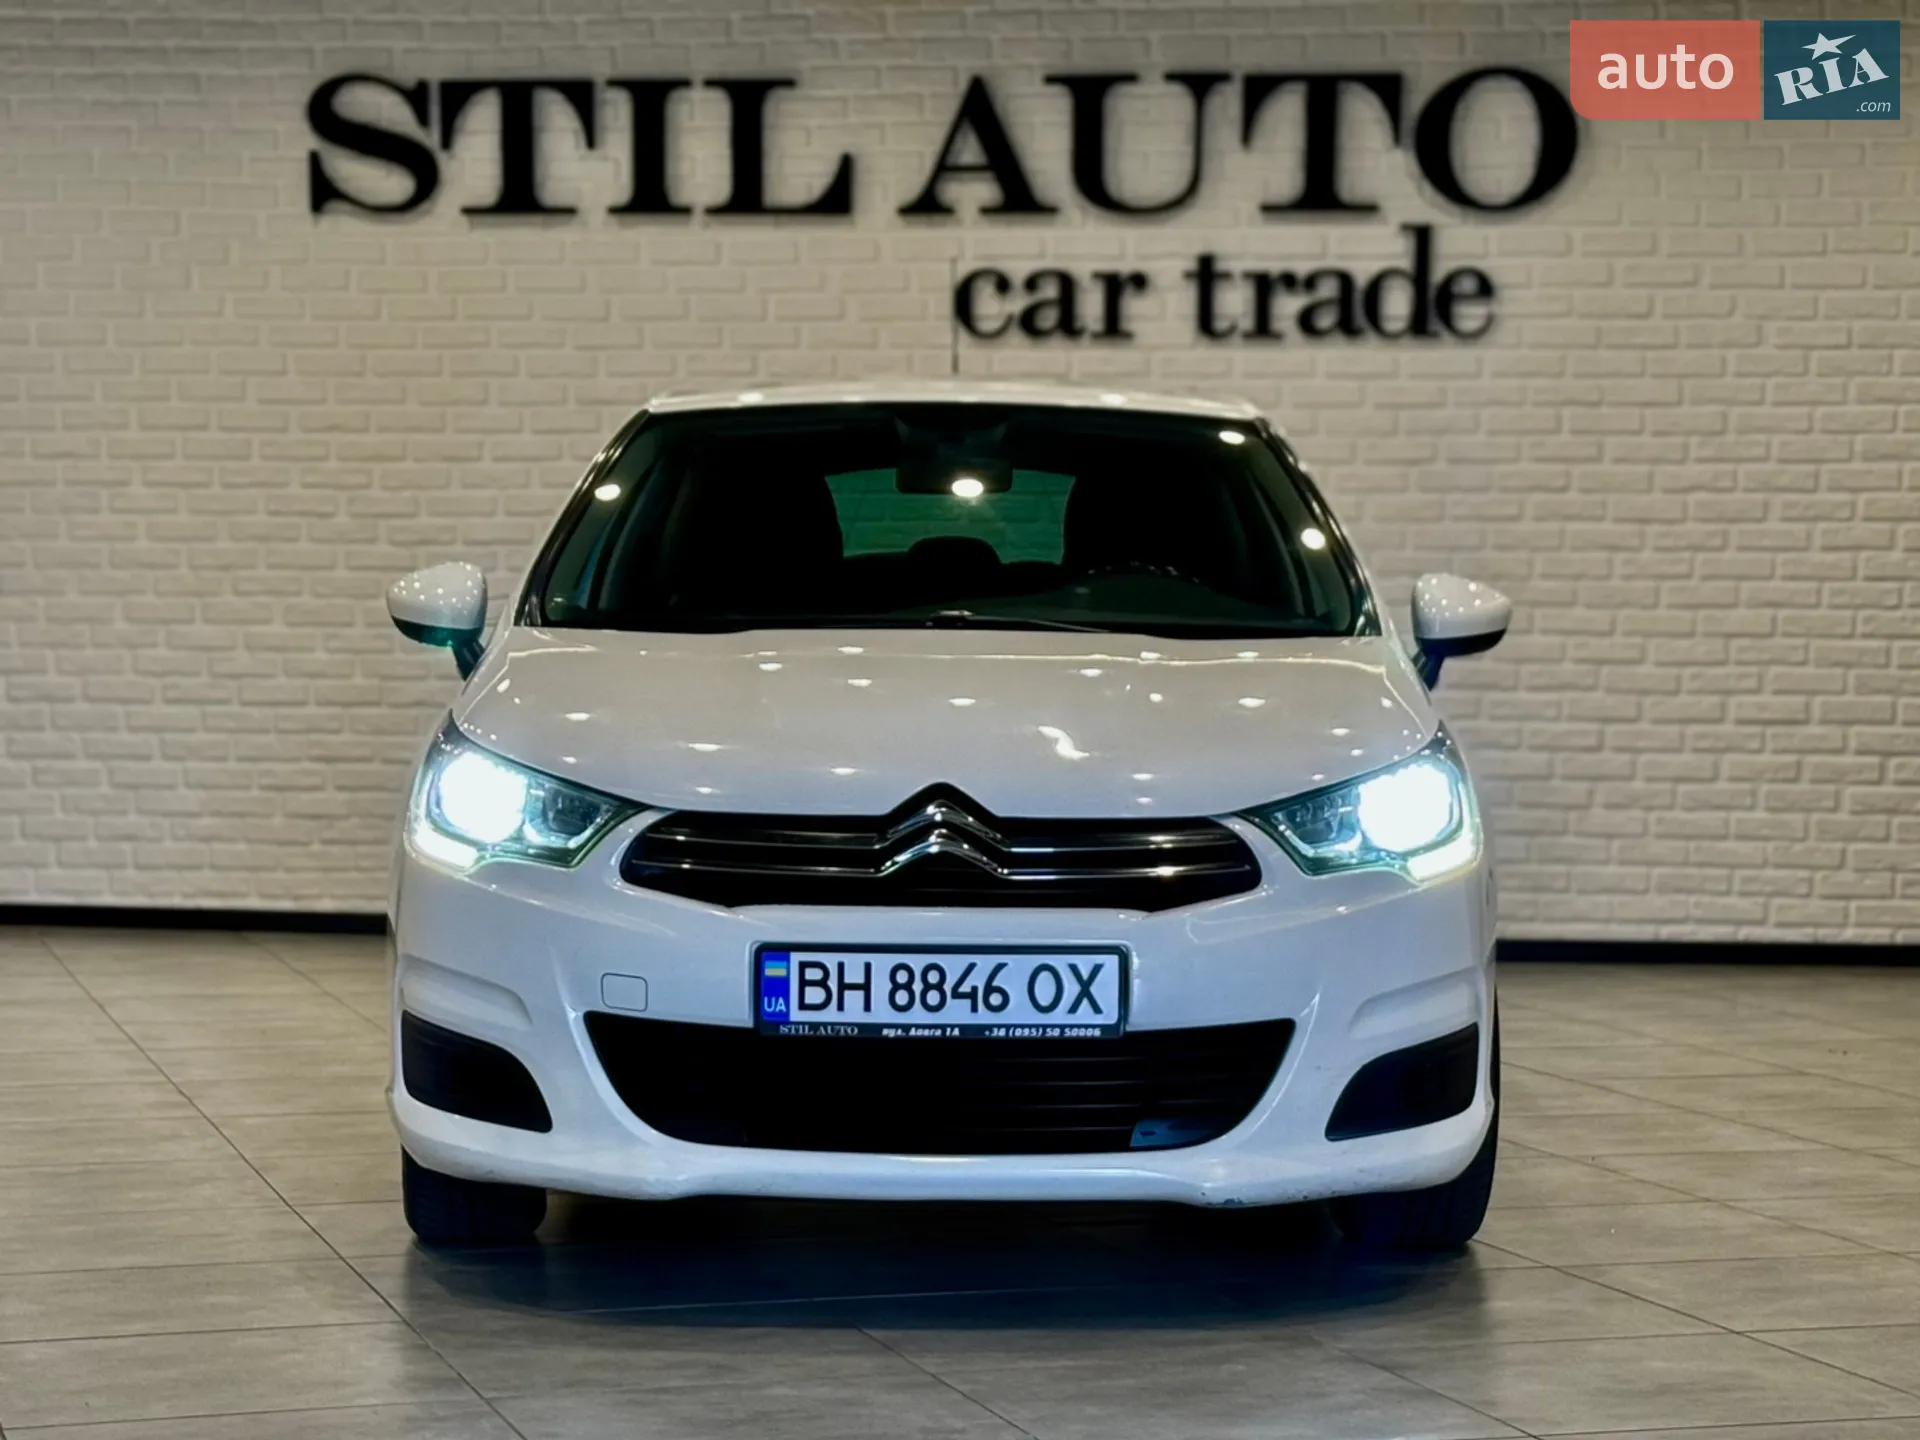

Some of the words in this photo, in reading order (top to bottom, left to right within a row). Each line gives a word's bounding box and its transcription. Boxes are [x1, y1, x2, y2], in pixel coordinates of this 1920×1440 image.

[307, 74, 853, 217] STIL
[898, 68, 1579, 217] AUTO
[954, 264, 1147, 342] car
[1188, 225, 1496, 342] trade
[763, 995, 786, 1013] UA
[797, 960, 873, 1013] BH
[888, 961, 1010, 1014] 8846
[1027, 962, 1105, 1015] OX
[816, 1025, 859, 1036] AUTO
